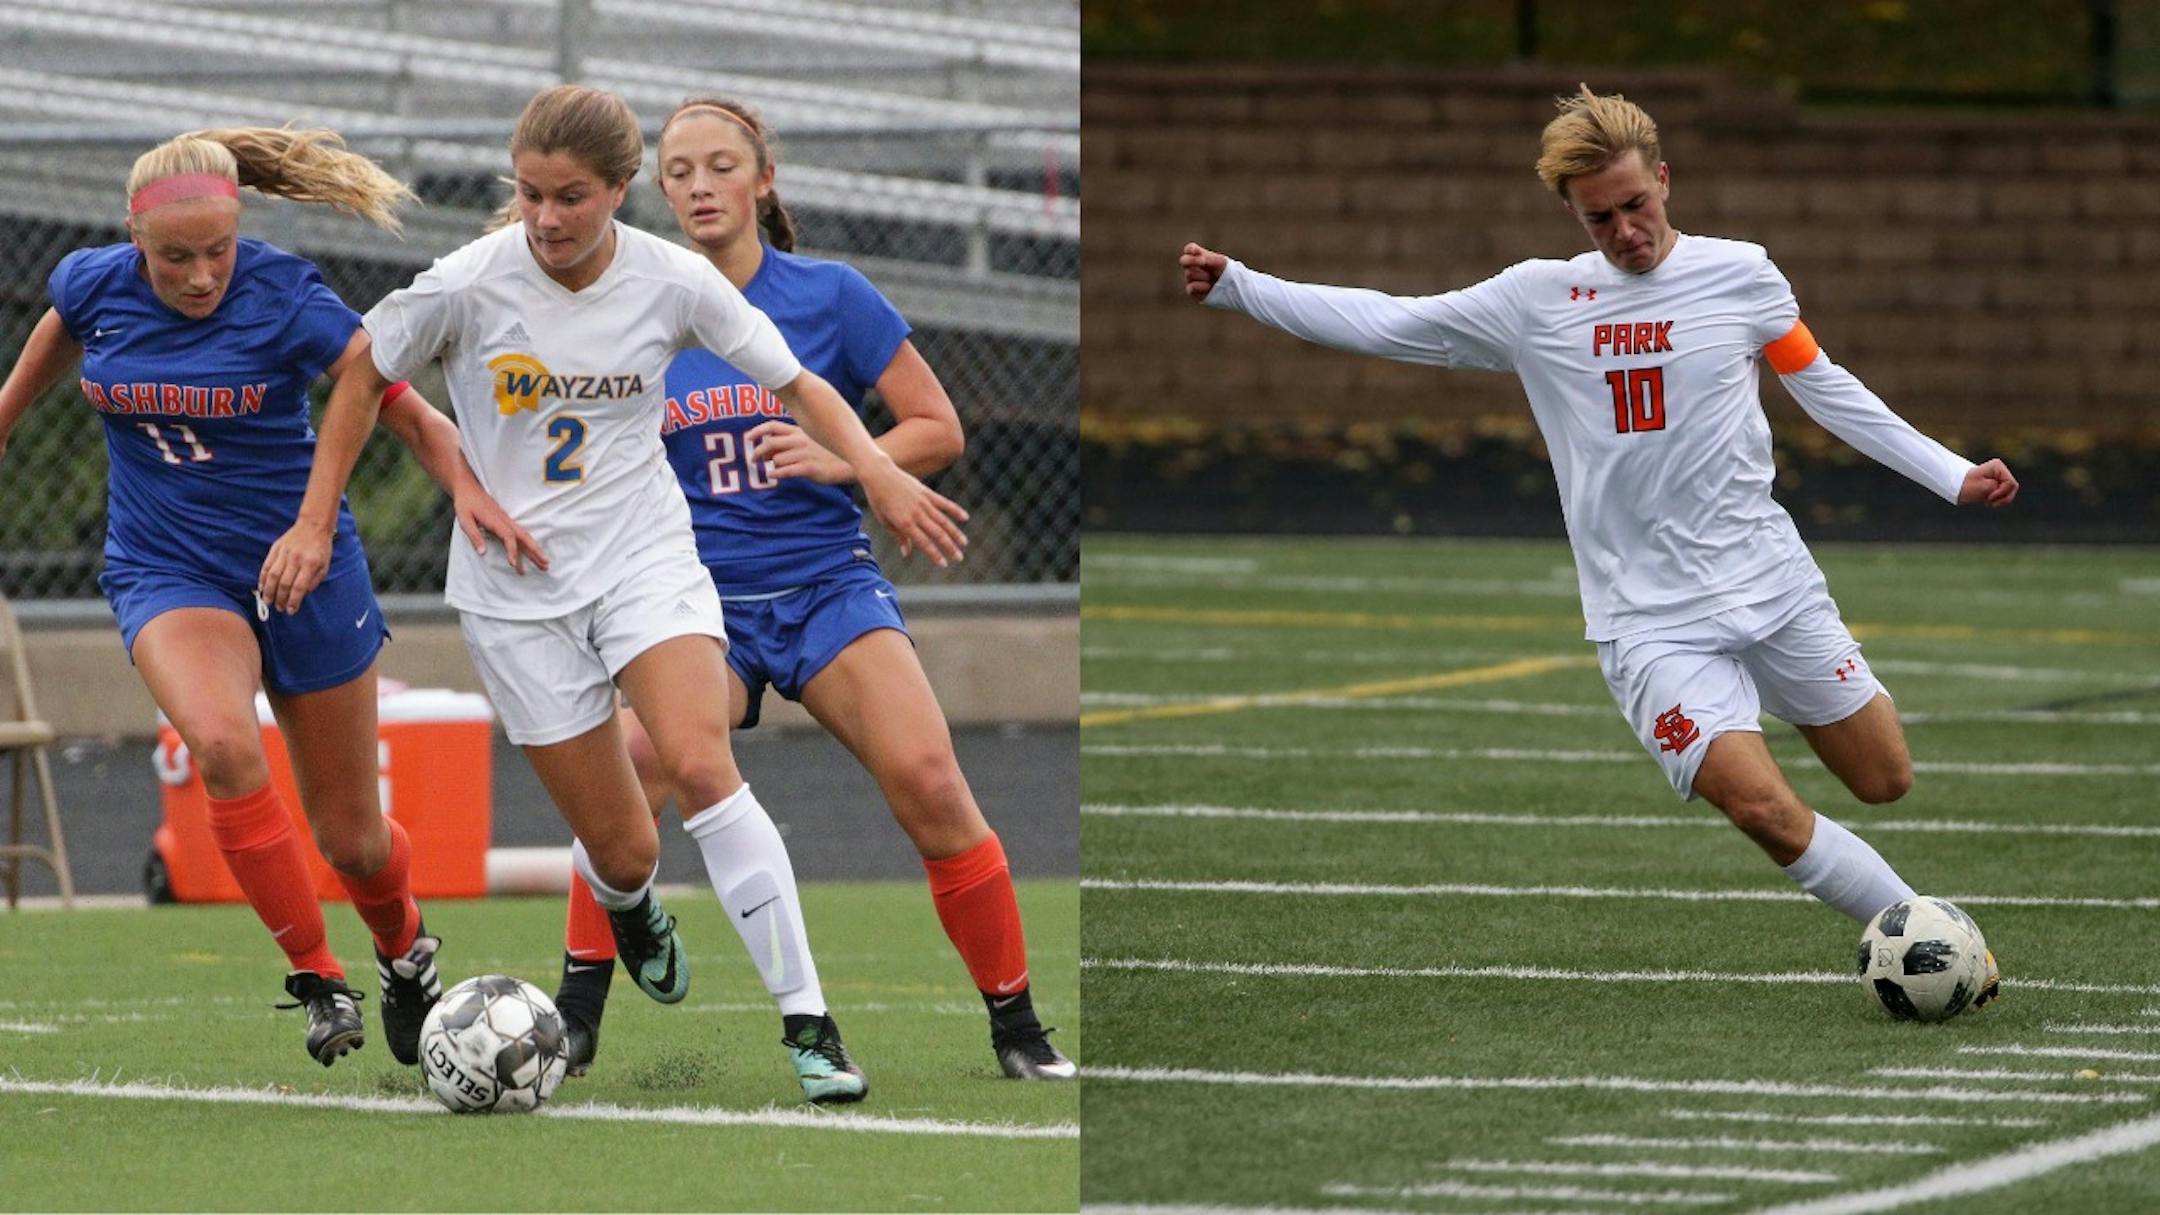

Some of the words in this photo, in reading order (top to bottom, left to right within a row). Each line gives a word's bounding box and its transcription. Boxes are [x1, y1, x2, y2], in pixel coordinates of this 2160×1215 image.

[1593, 320, 1674, 357] PARK
[502, 370, 643, 399] WAYZATA
[1605, 366, 1666, 434] 10
[136, 422, 214, 464] 11
[543, 413, 589, 488] 2
[429, 1041, 490, 1102] SELECT
